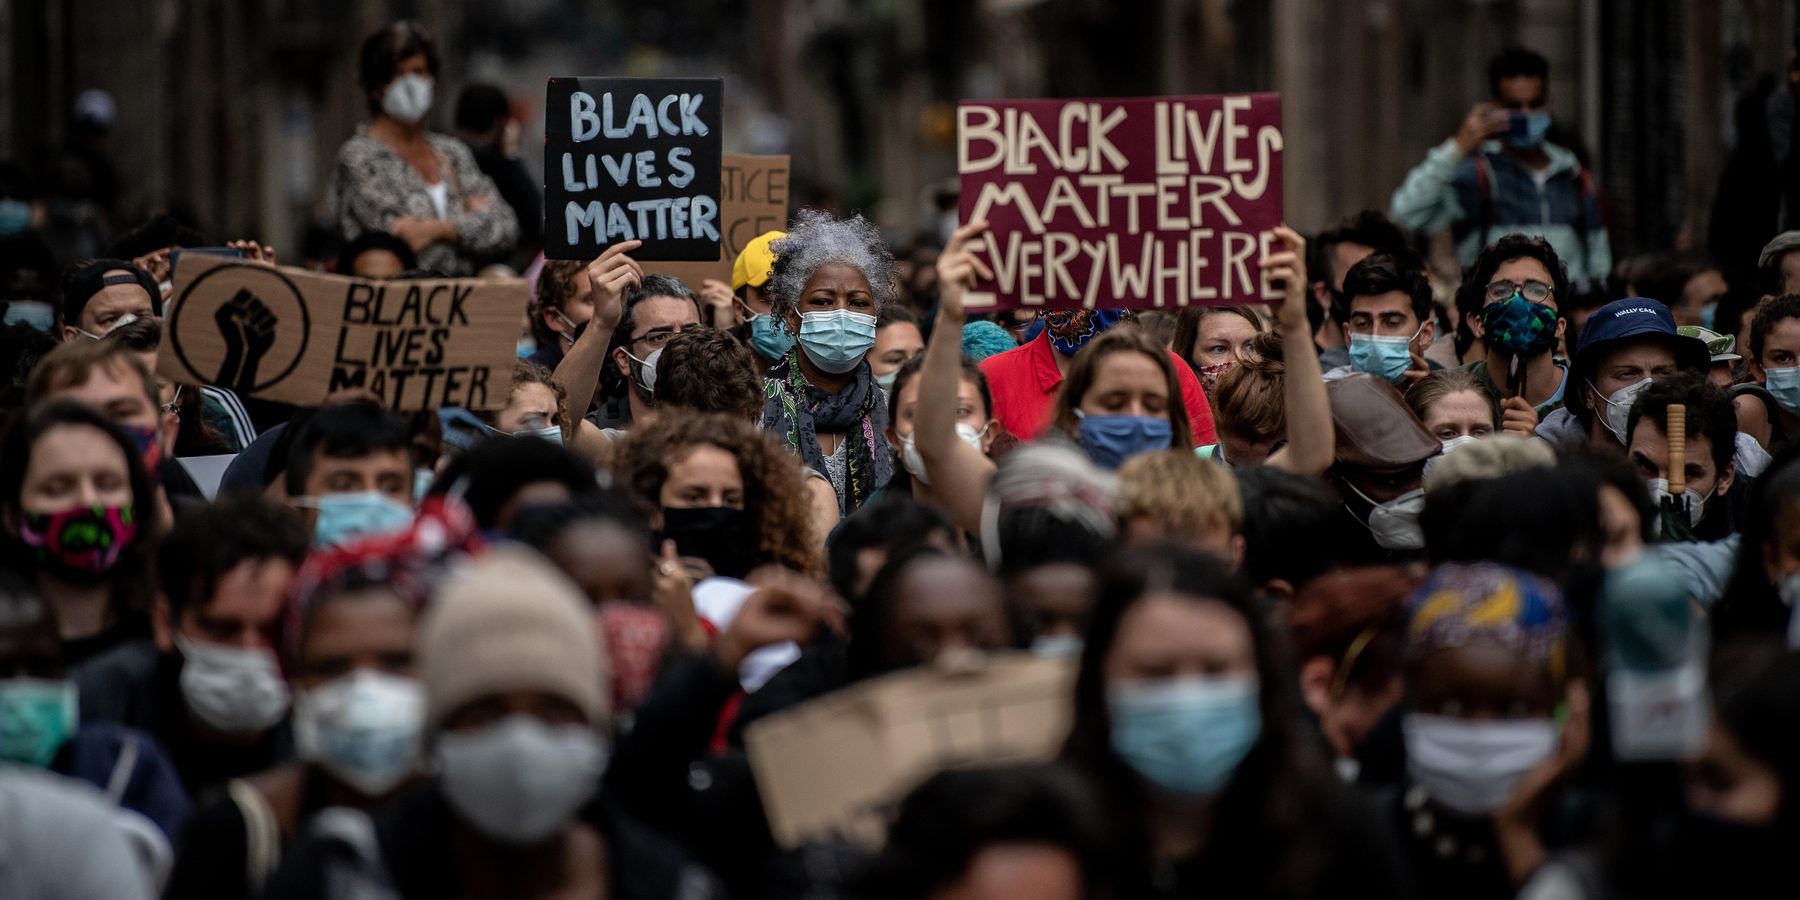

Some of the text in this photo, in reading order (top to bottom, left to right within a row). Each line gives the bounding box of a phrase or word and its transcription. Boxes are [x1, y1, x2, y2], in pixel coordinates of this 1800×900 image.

[570, 91, 709, 142] BLACK
[562, 147, 695, 191] LIVES
[957, 96, 1284, 200] BLACK LIVES
[721, 166, 787, 204] TICE
[970, 174, 1242, 235] MATTER
[565, 195, 720, 245] MATTER
[343, 283, 472, 326] BLACK
[334, 326, 449, 368] LIVES
